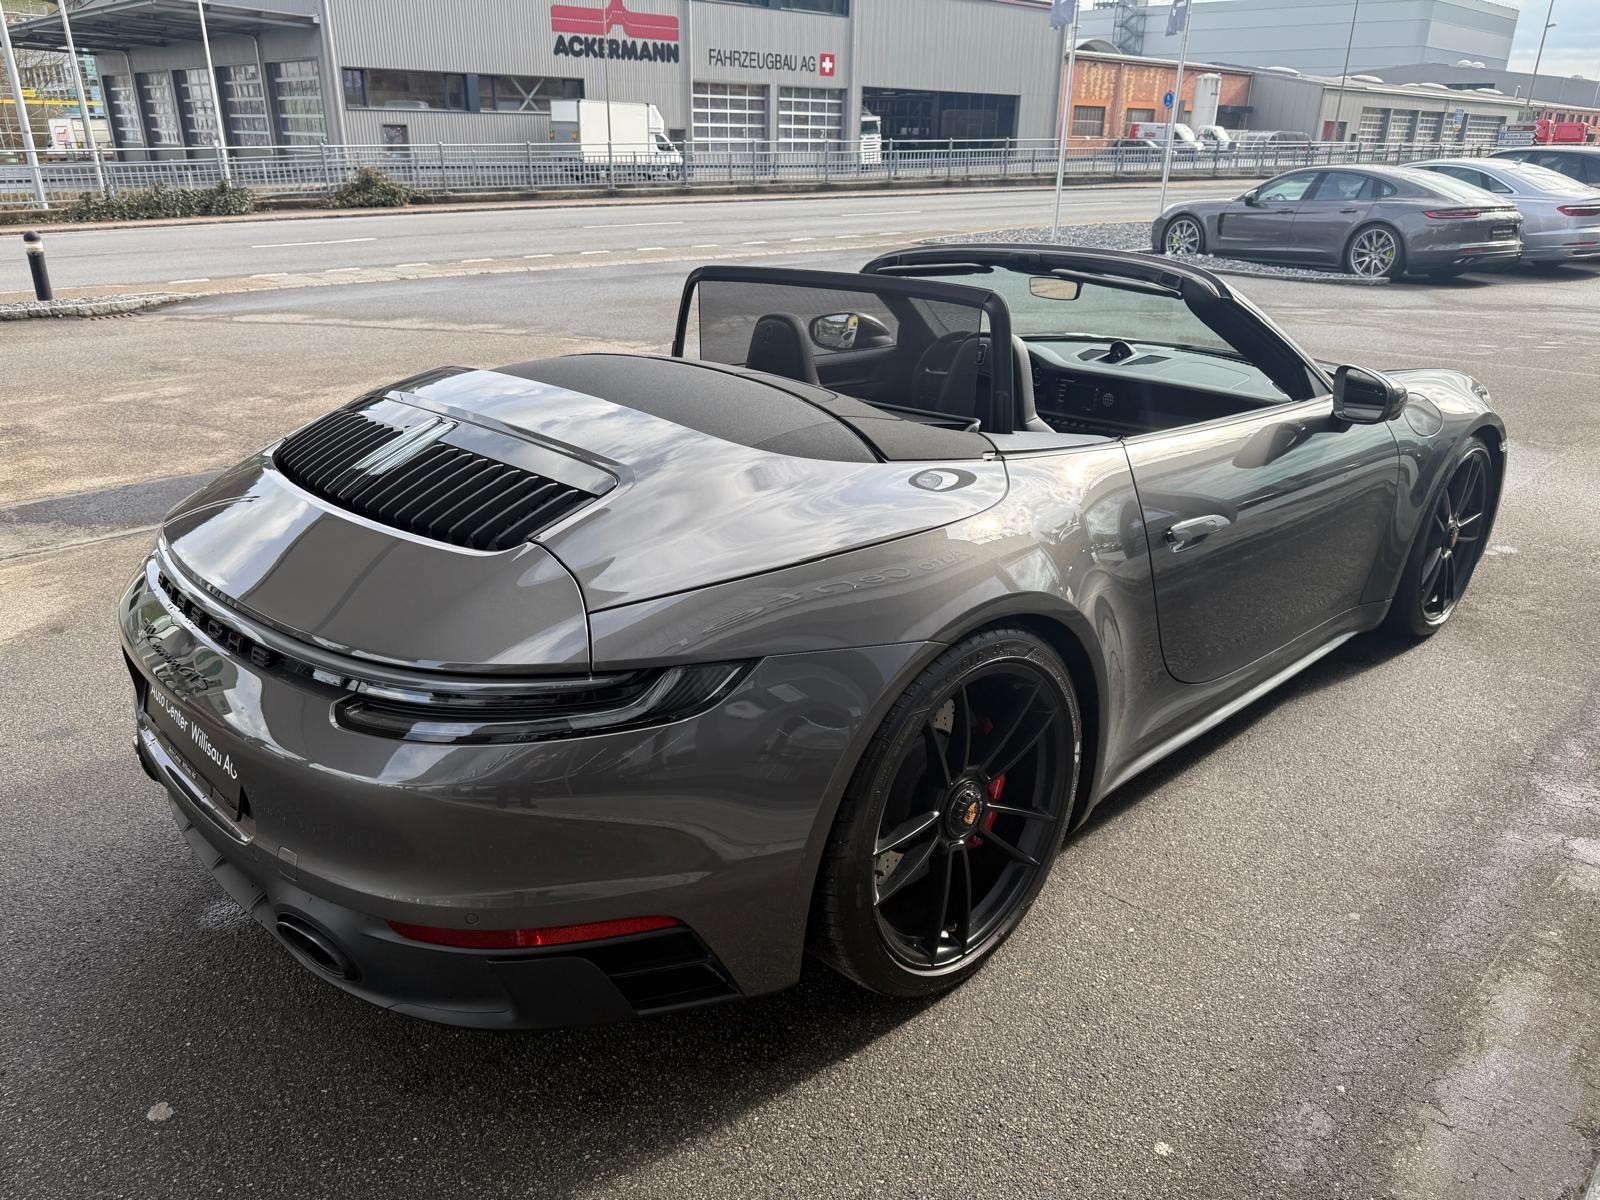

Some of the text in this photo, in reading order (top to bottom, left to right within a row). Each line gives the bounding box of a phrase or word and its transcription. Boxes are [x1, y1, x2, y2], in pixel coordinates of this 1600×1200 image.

[553, 34, 680, 63] ACKERMANN
[708, 48, 816, 73] FAHRZEUGBAU AG
[165, 700, 189, 732] Center
[190, 721, 223, 767] Willisau
